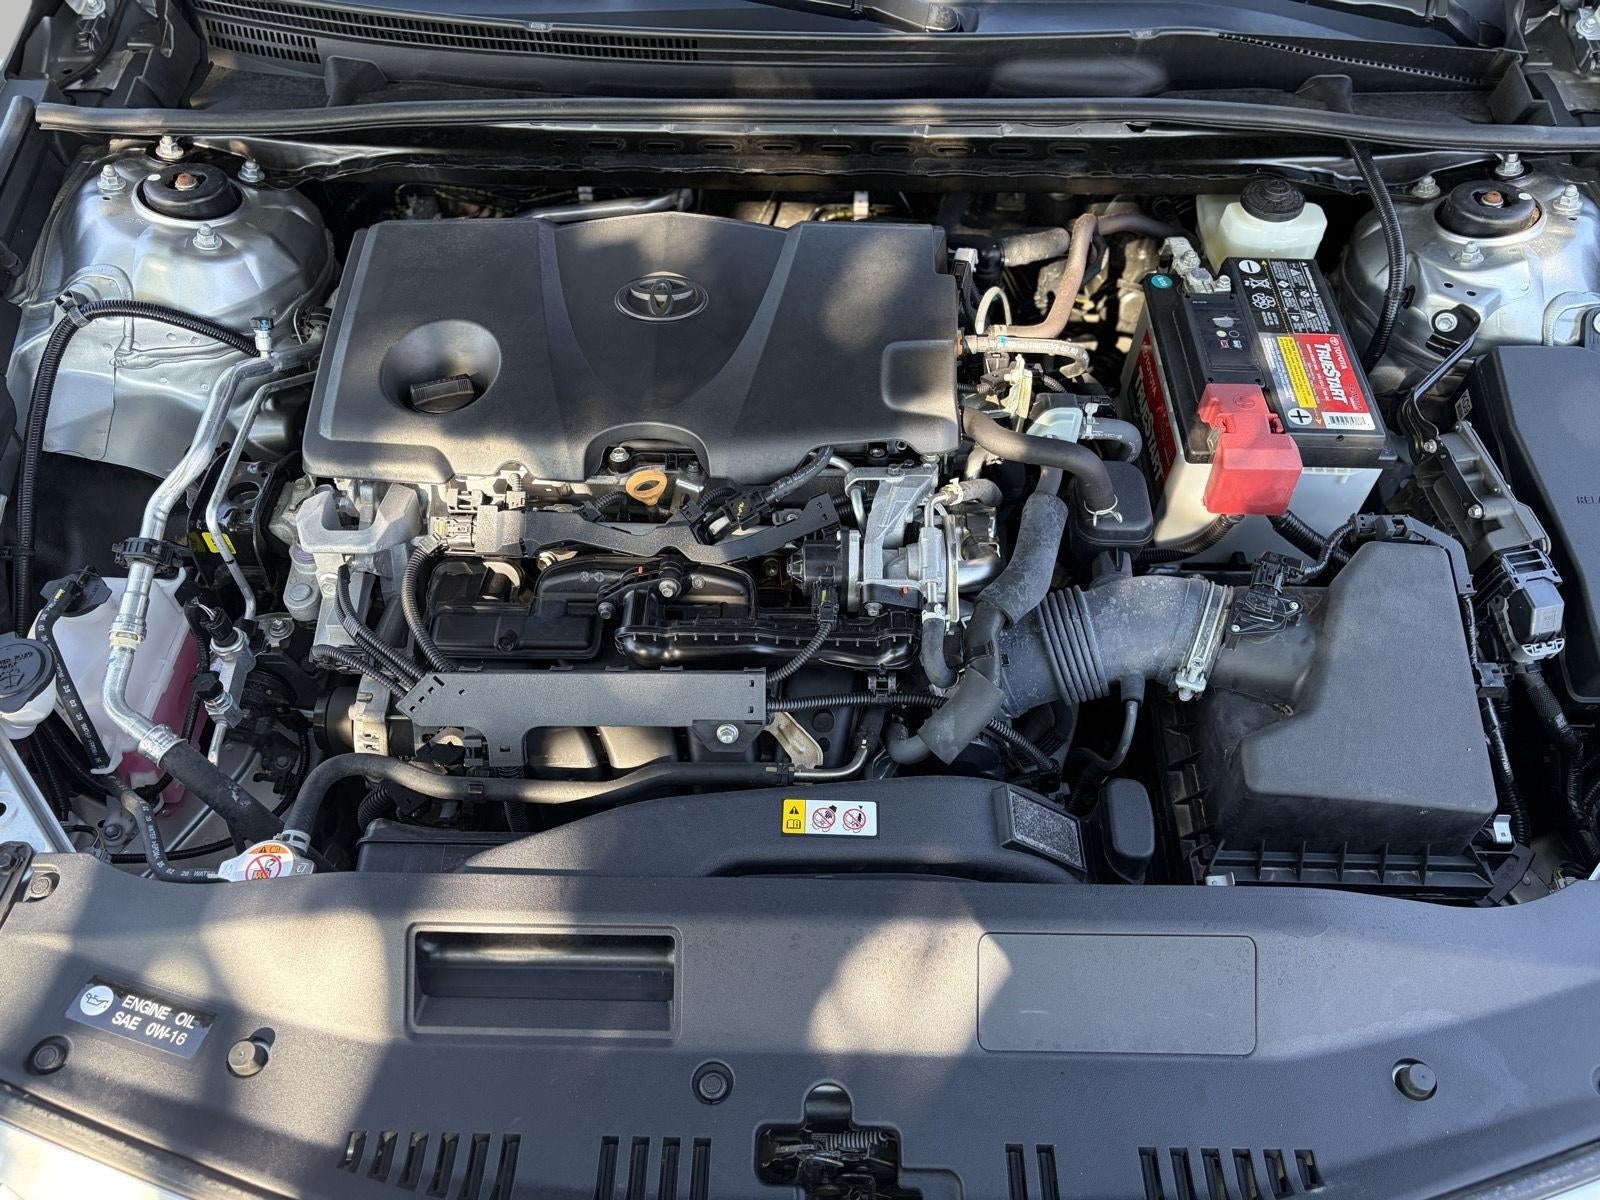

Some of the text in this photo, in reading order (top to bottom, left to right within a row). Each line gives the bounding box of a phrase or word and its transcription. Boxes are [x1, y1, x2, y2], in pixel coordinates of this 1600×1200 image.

[1334, 346, 1347, 370] TOYOTA
[111, 1011, 188, 1046] SAE 0W-16
[121, 995, 197, 1030] ENGINE OIL
